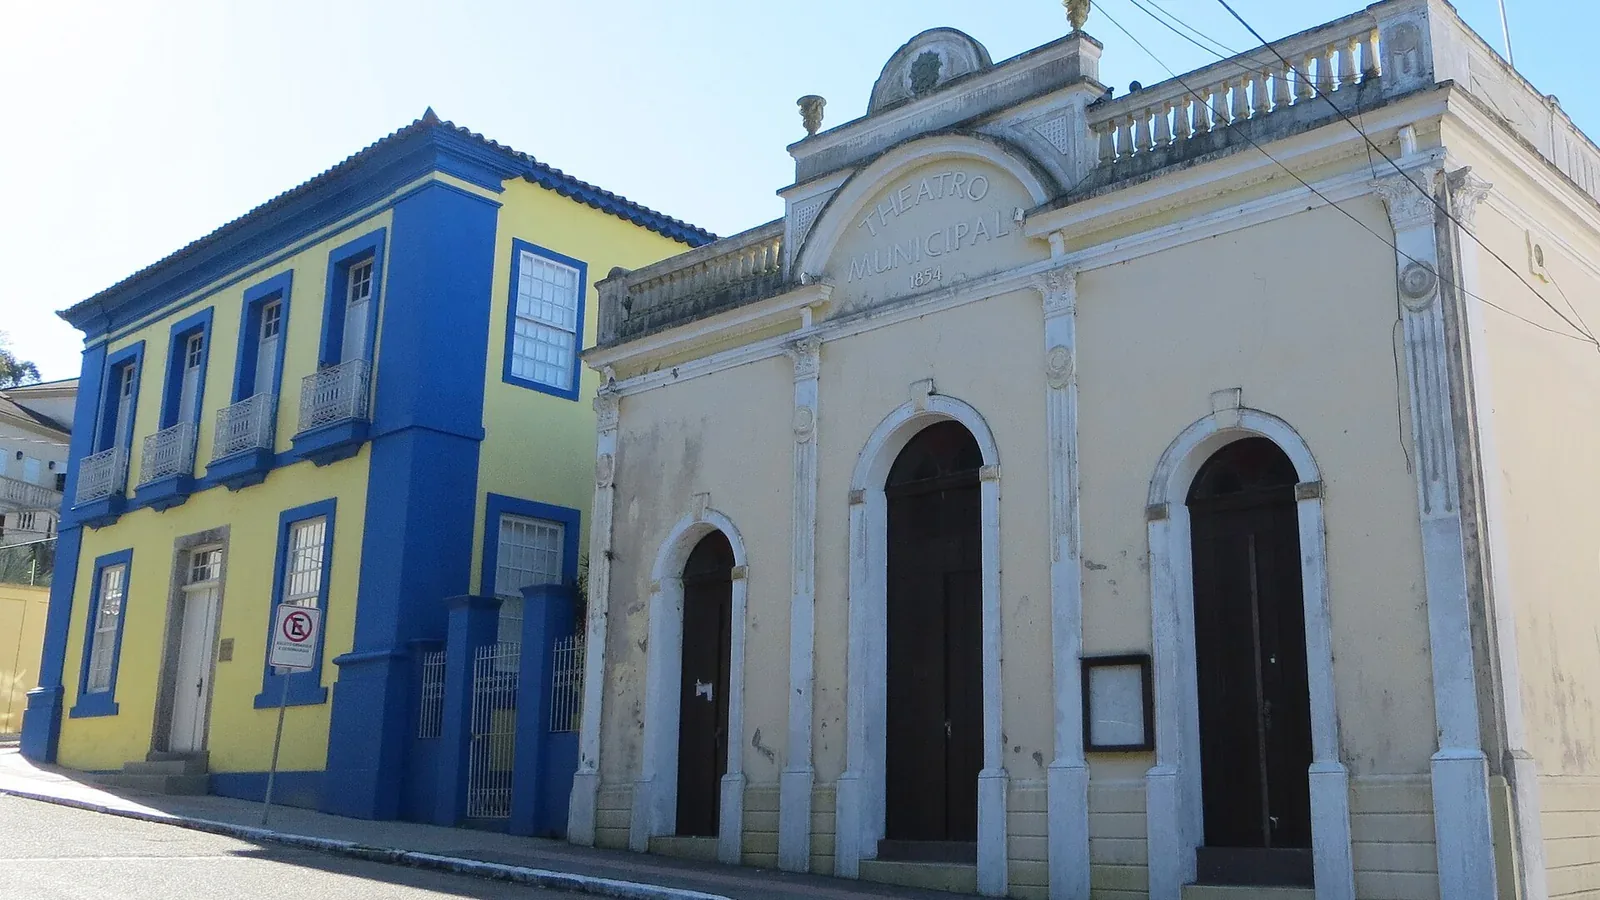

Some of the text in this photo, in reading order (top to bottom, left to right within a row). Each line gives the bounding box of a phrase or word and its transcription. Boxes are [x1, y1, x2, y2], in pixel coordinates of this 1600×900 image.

[858, 171, 989, 237] THEATRO
[848, 211, 1009, 283] MUNICIPAL
[909, 265, 942, 289] 1854
[291, 617, 304, 636] E
